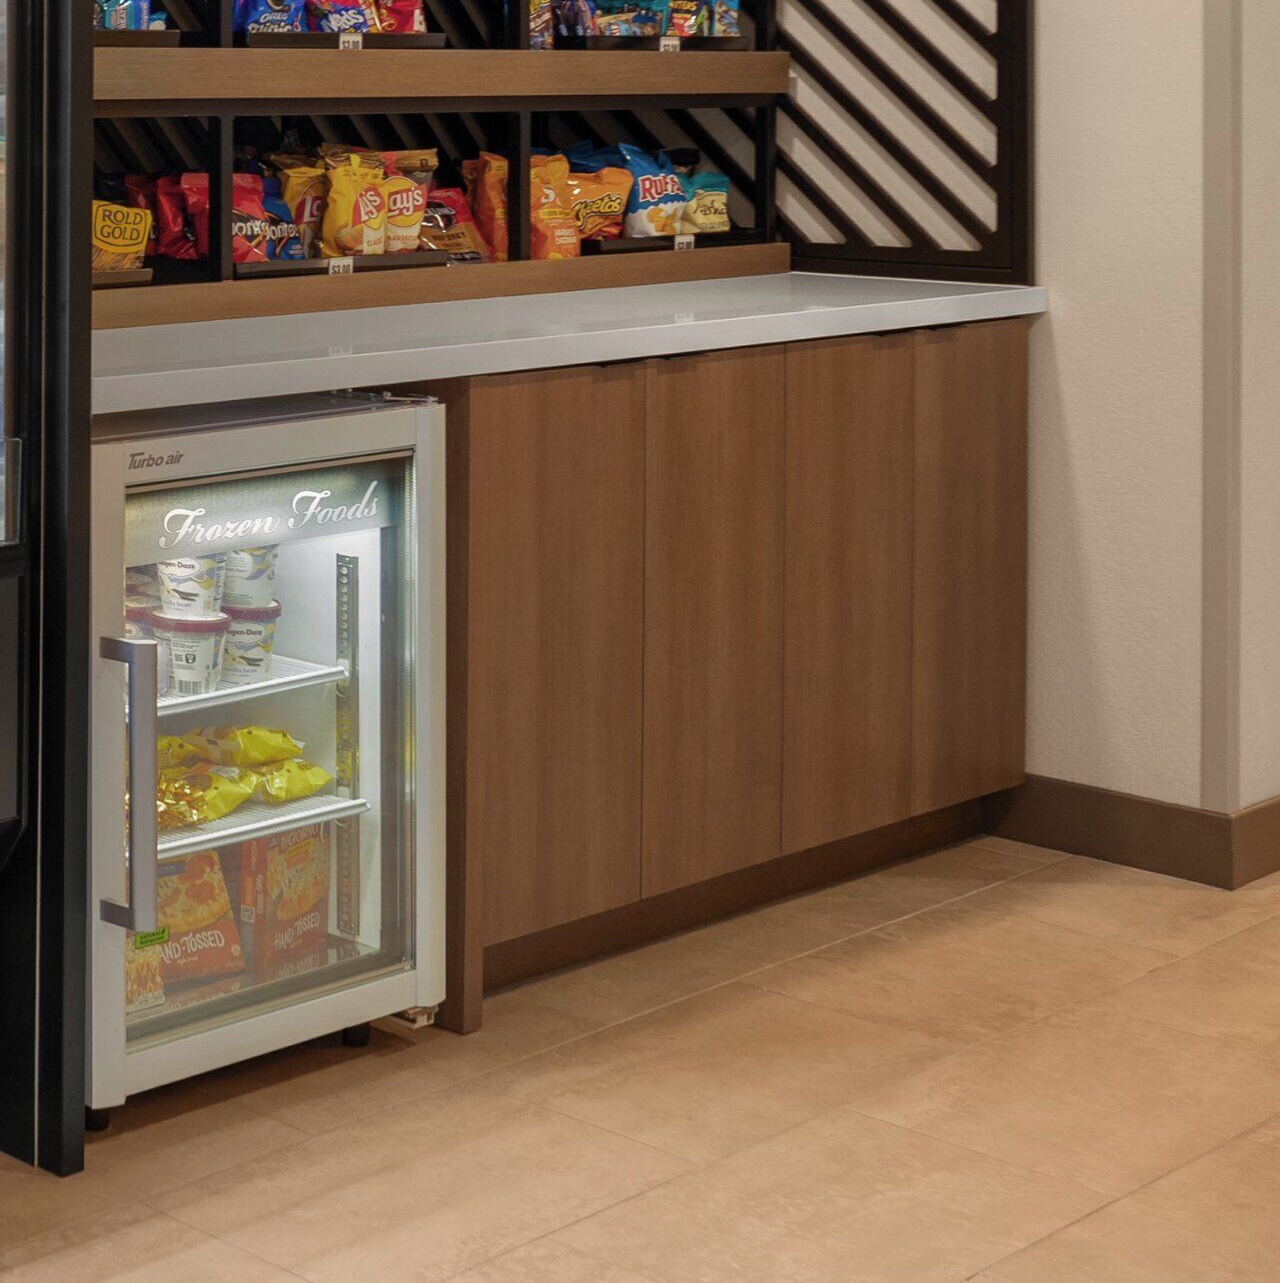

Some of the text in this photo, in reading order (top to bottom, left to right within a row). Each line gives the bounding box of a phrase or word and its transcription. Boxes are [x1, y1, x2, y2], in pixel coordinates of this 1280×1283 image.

[260, 13, 289, 24] OREO
[101, 208, 143, 226] ROLD
[99, 224, 140, 242] GOLD
[128, 450, 184, 470] Turbo air
[158, 480, 381, 550] Frozen Foods
[139, 931, 163, 942] NATURAL
[272, 911, 322, 952] HAND-TOSSED
